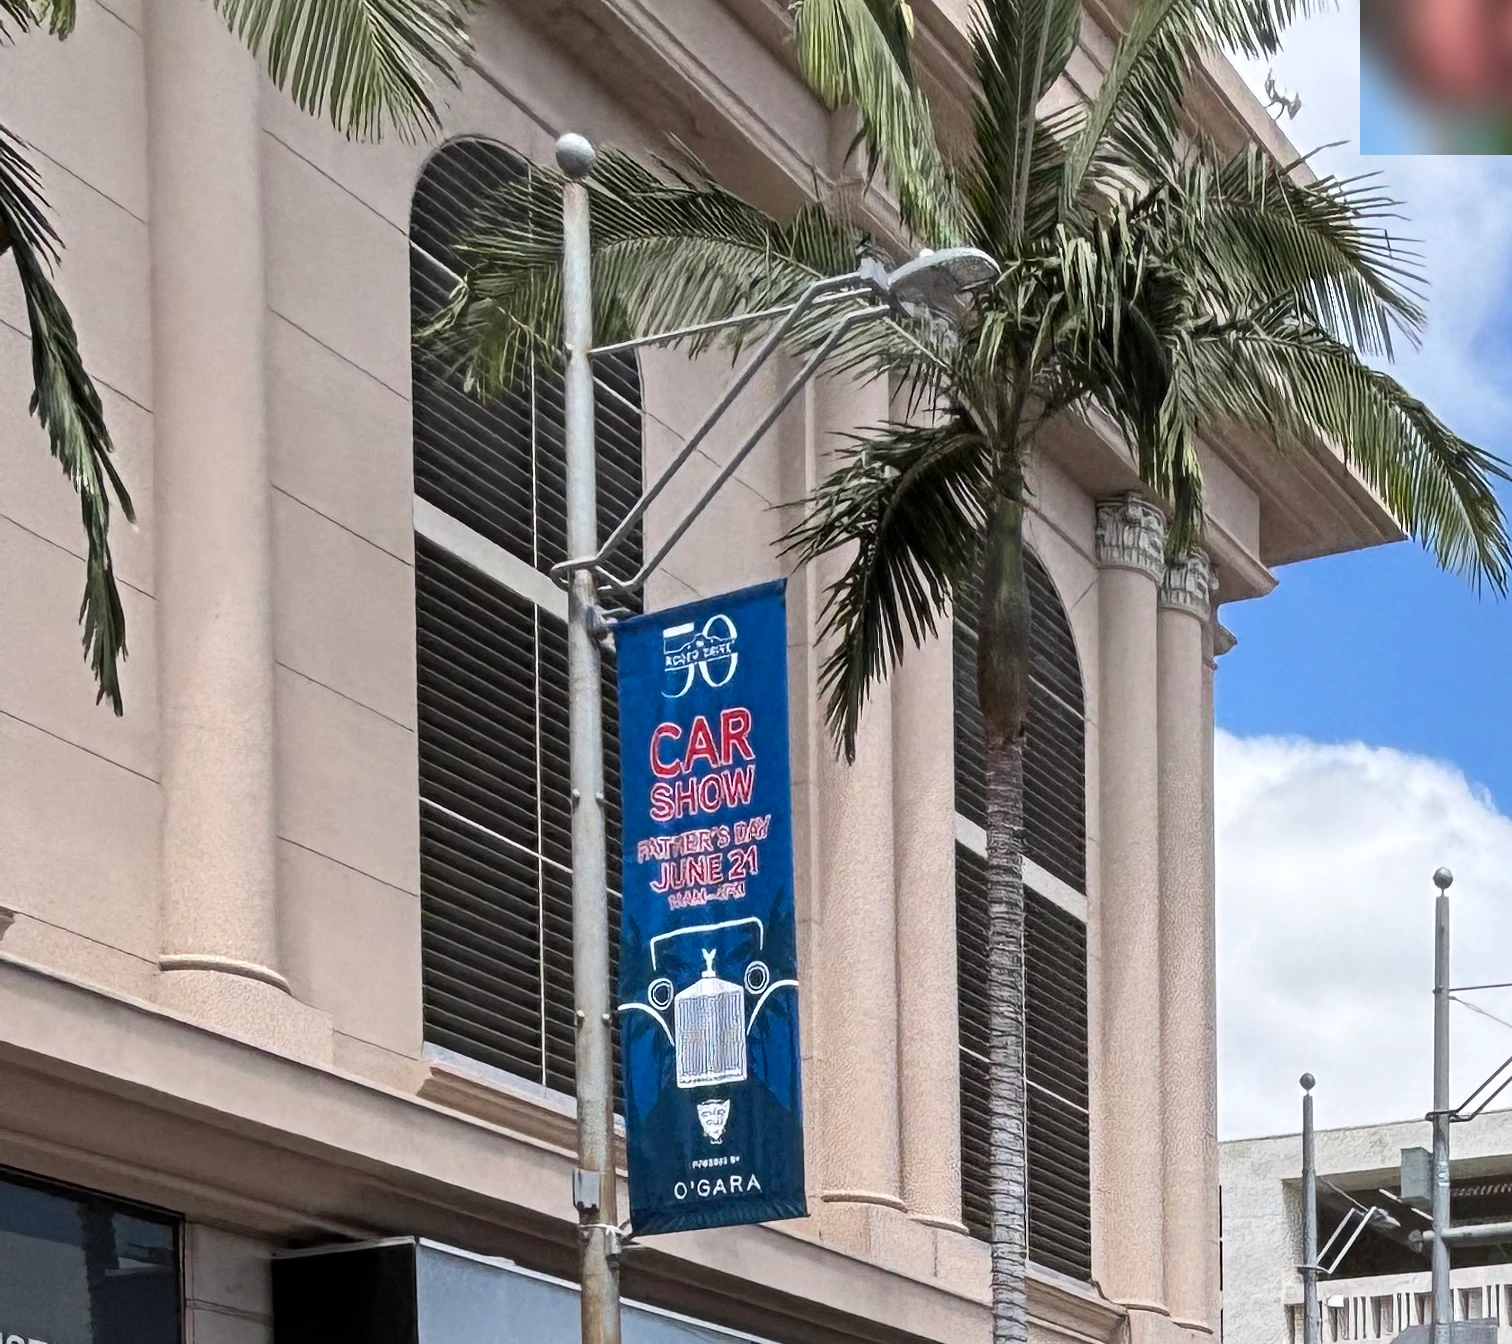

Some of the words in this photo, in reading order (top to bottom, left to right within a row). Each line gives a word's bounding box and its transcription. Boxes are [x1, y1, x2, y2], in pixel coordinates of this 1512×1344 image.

[650, 707, 755, 778] CAR
[650, 765, 755, 822] SHOW
[637, 825, 731, 864] FATHER'S
[733, 814, 772, 845] DAY
[649, 853, 724, 893] JUNE
[727, 845, 760, 880] 21
[674, 1173, 763, 1200] O'GARA
